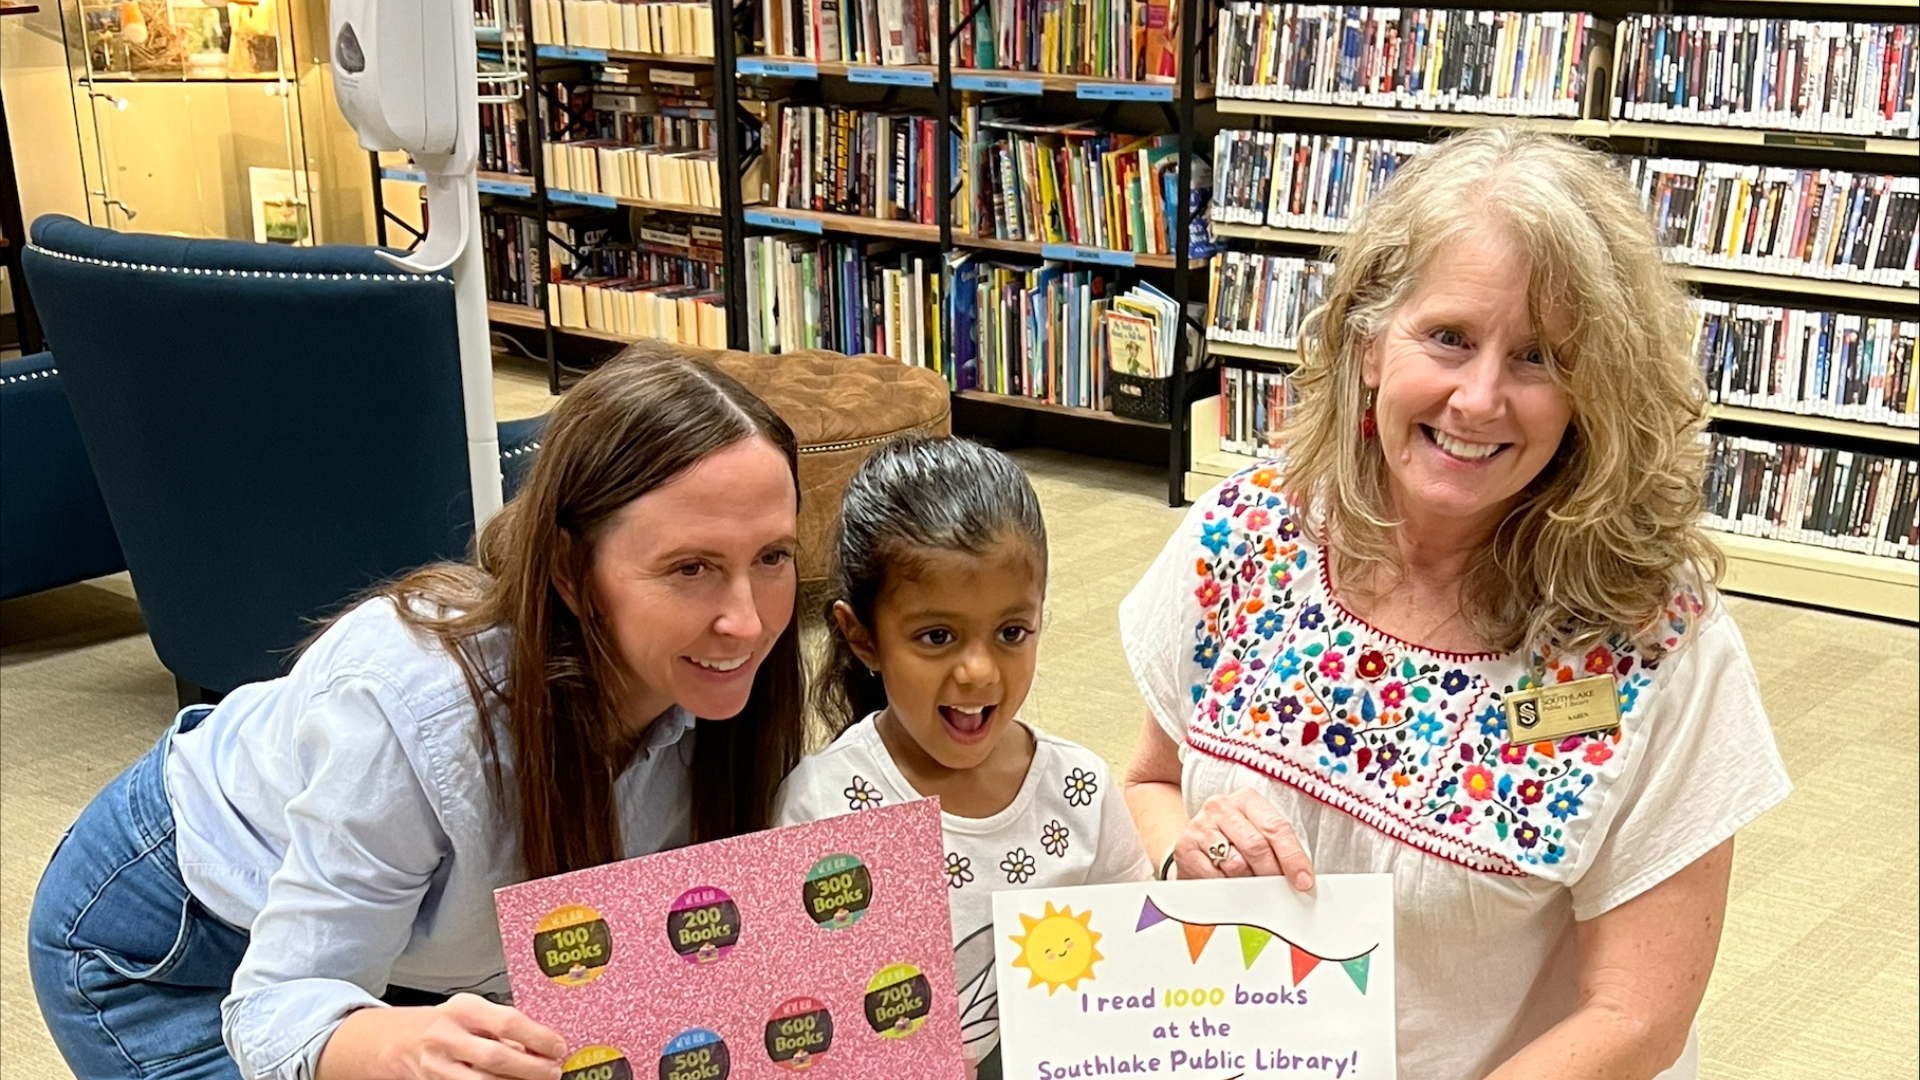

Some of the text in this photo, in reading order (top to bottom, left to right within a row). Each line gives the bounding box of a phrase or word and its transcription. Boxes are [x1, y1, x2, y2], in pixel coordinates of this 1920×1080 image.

[817, 873, 853, 896] 300
[812, 888, 864, 914] Books
[682, 906, 721, 928] 200
[553, 926, 590, 949] 100
[678, 923, 731, 945] Books
[545, 943, 603, 967] Books
[879, 982, 912, 1006] 700
[1082, 983, 1308, 1013] I read 1000 books
[875, 995, 923, 1023] Books
[781, 1014, 816, 1036] 600
[1152, 1016, 1231, 1039] at the
[775, 1031, 824, 1052] Books
[675, 1048, 711, 1070] 500
[1037, 1047, 1358, 1080] Southlake Public Library!
